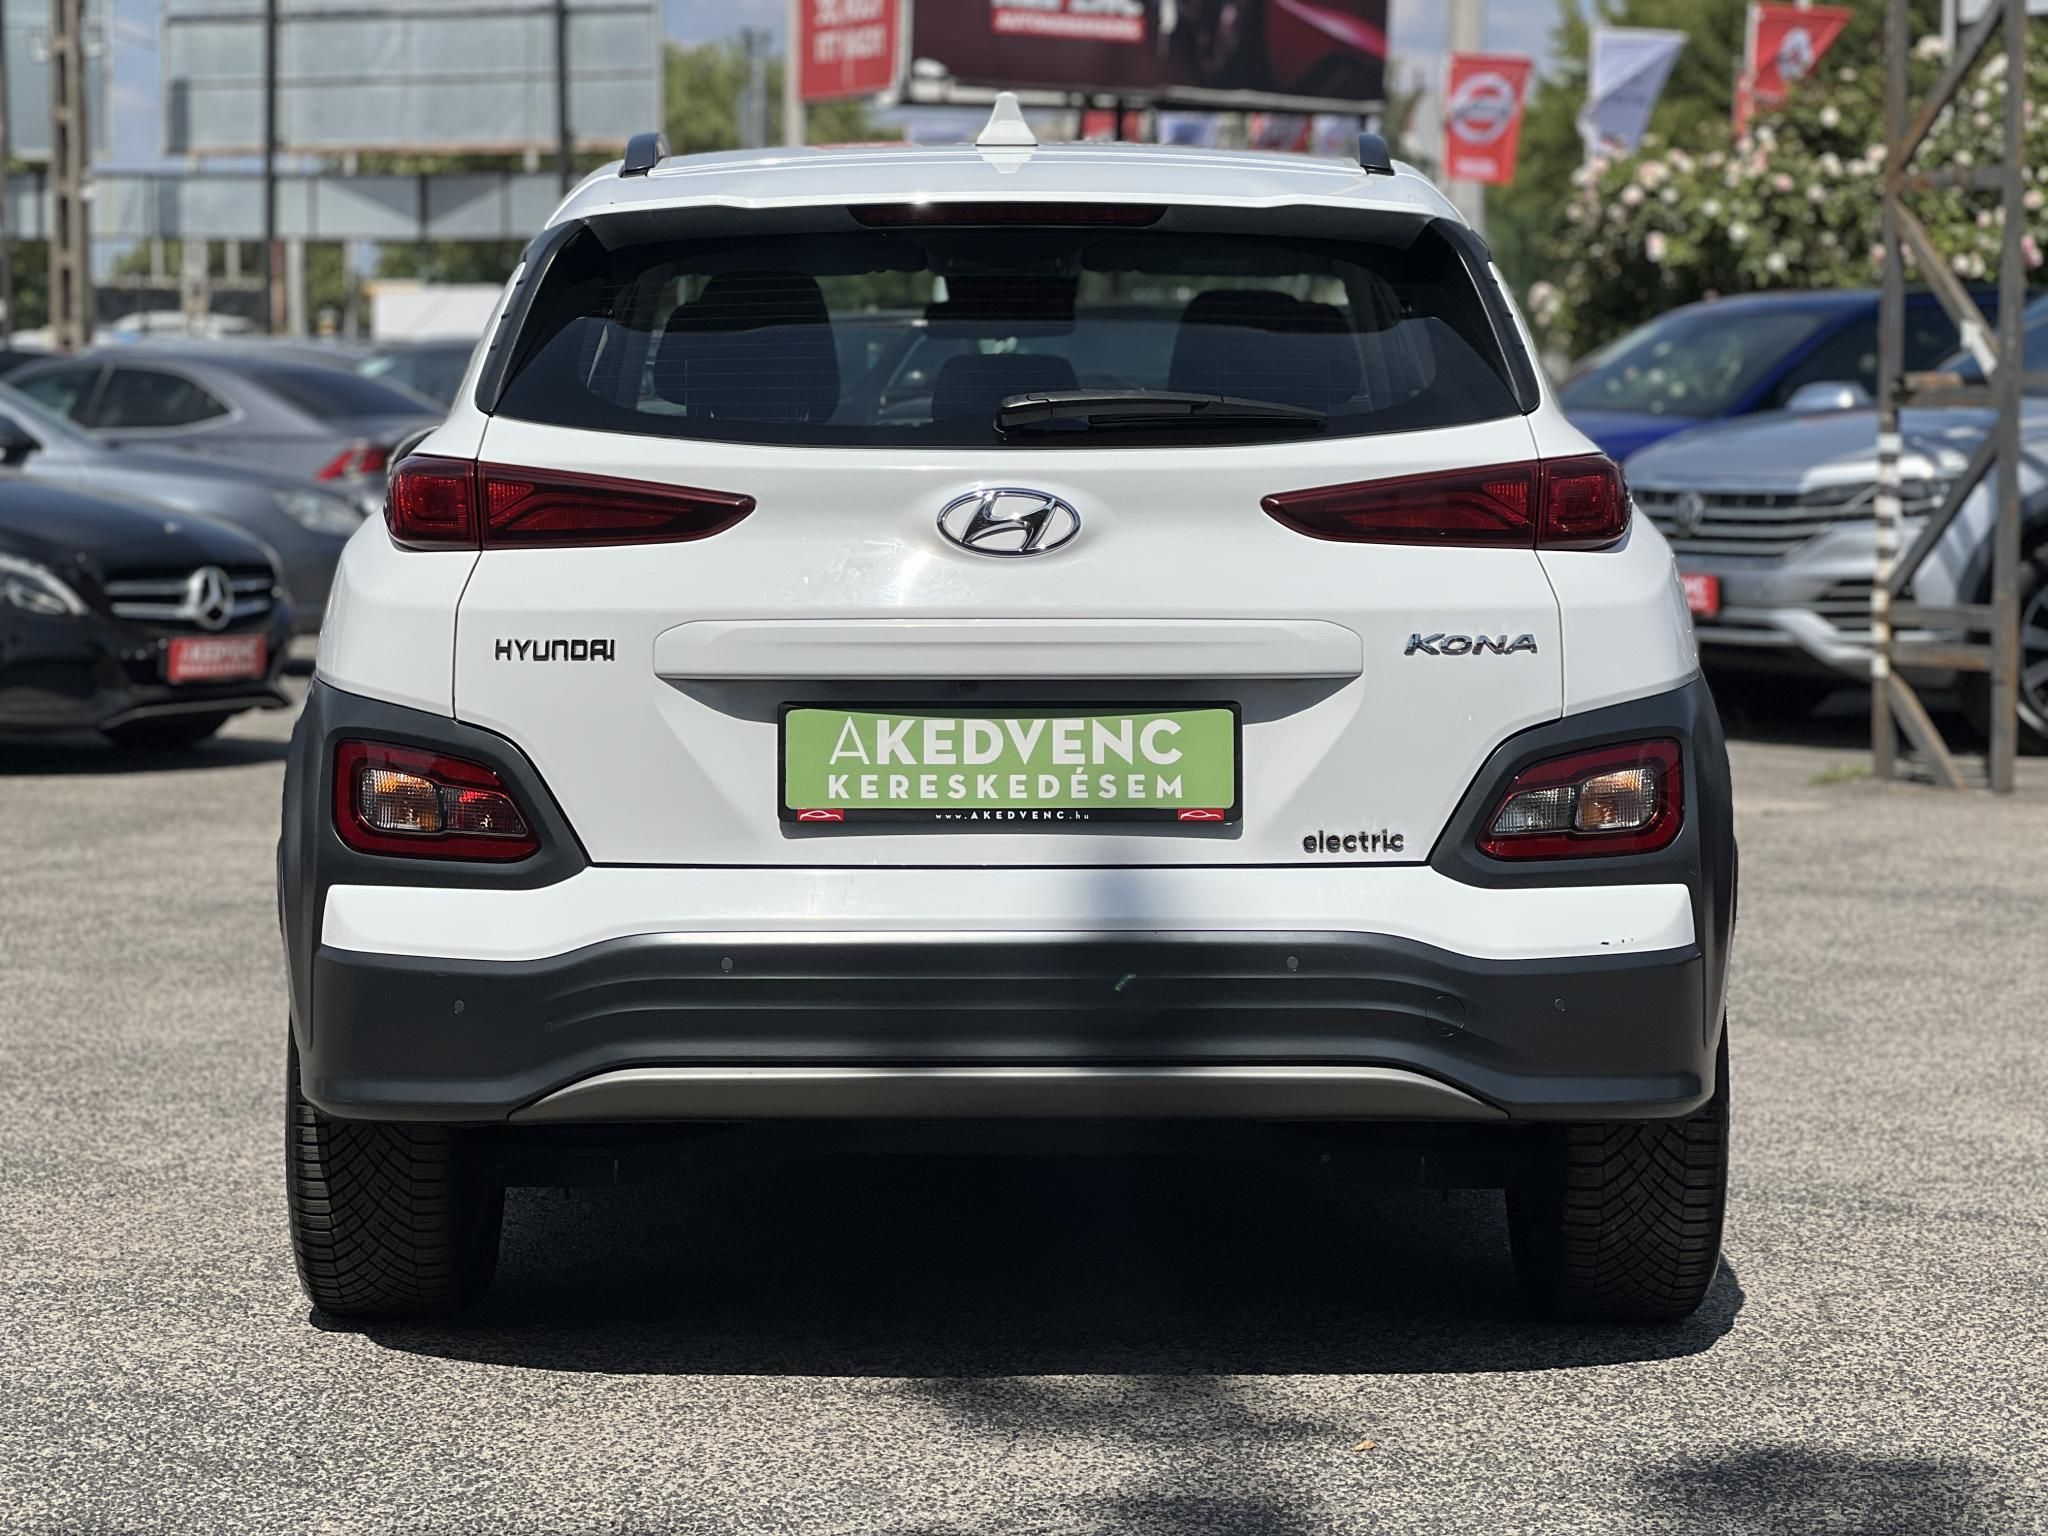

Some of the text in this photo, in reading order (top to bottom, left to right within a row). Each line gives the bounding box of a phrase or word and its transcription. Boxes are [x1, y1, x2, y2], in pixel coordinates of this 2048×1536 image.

[495, 638, 615, 661] HYUNDAI
[1403, 633, 1538, 656] KONA
[828, 715, 1183, 765] AKEDVENC
[828, 767, 1183, 799] KERESKEDÉSEM
[935, 810, 1090, 820] www.AKEDVENC.hu
[1303, 828, 1405, 853] electric
